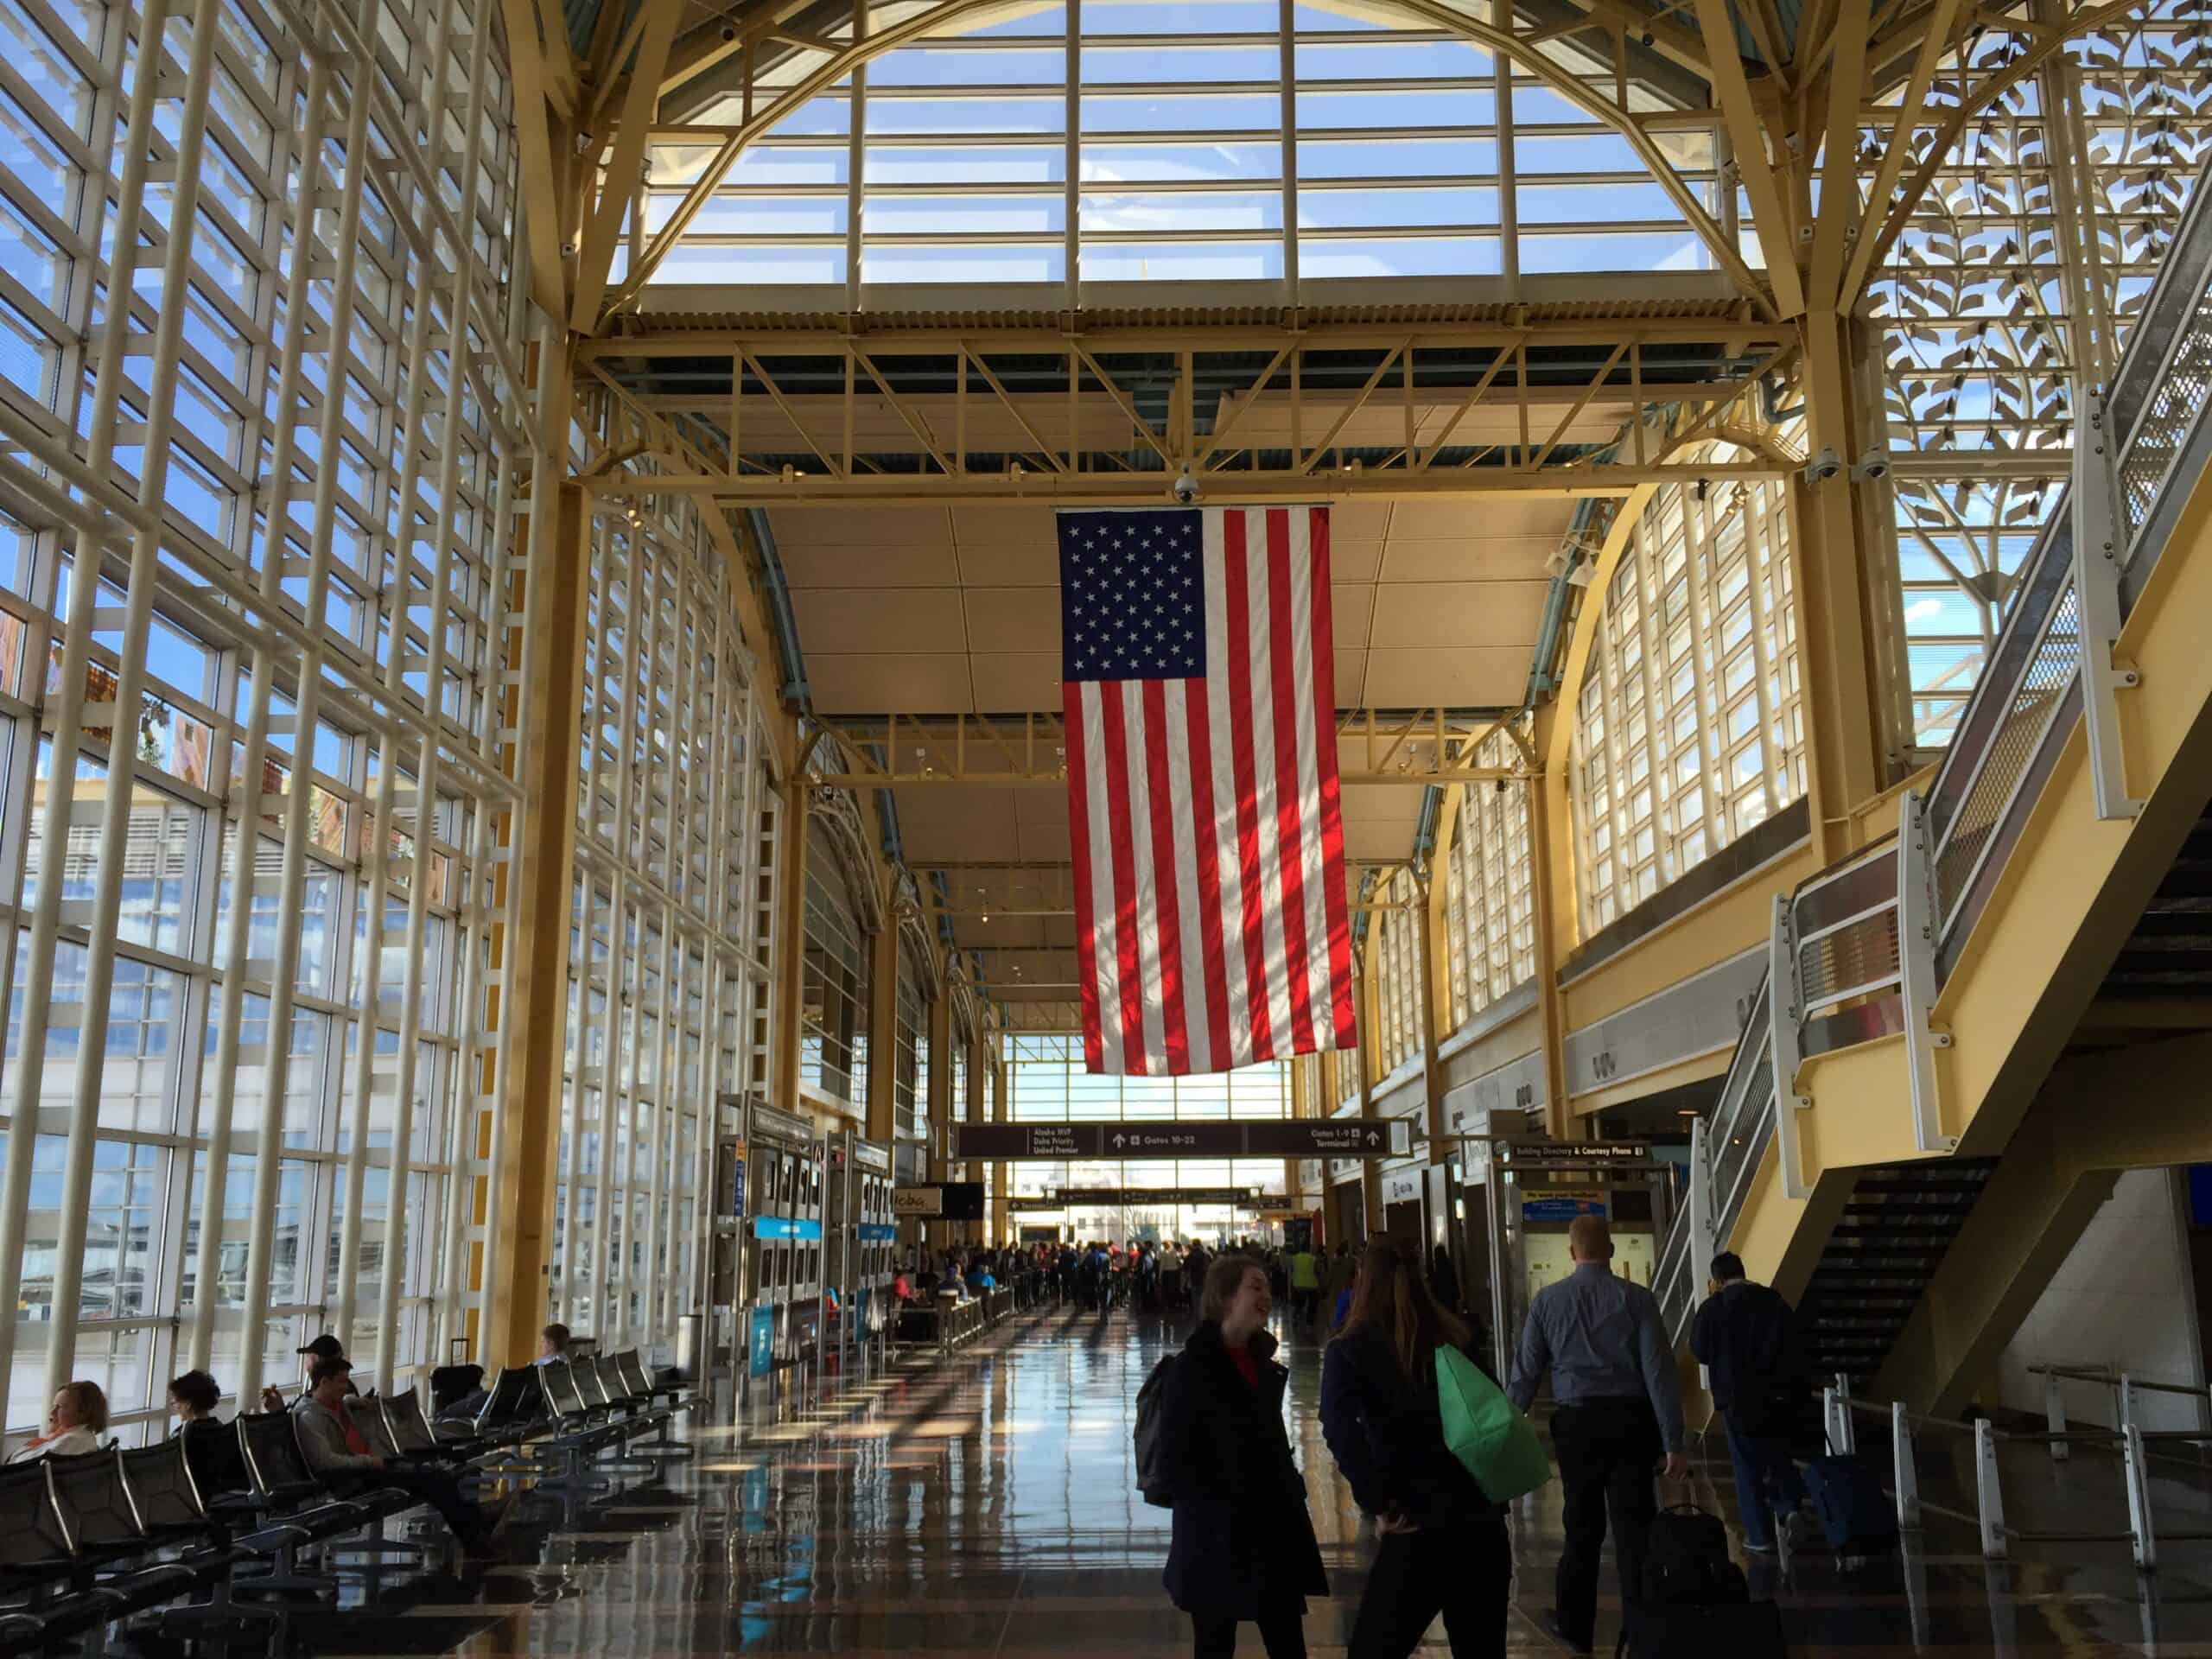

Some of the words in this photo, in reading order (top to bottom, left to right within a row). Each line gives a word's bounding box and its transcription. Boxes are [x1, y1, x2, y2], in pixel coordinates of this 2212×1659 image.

[1311, 1128, 1333, 1138] Gates
[1144, 1135, 1168, 1145] Gates
[1171, 1135, 1196, 1145] 10-22
[1316, 1138, 1350, 1147] Terminal
[1516, 1147, 1541, 1157] Building
[1543, 1147, 1572, 1156] Directory
[1574, 1147, 1580, 1155] &
[1582, 1147, 1610, 1157] Courtesy
[1611, 1147, 1631, 1155] Phone
